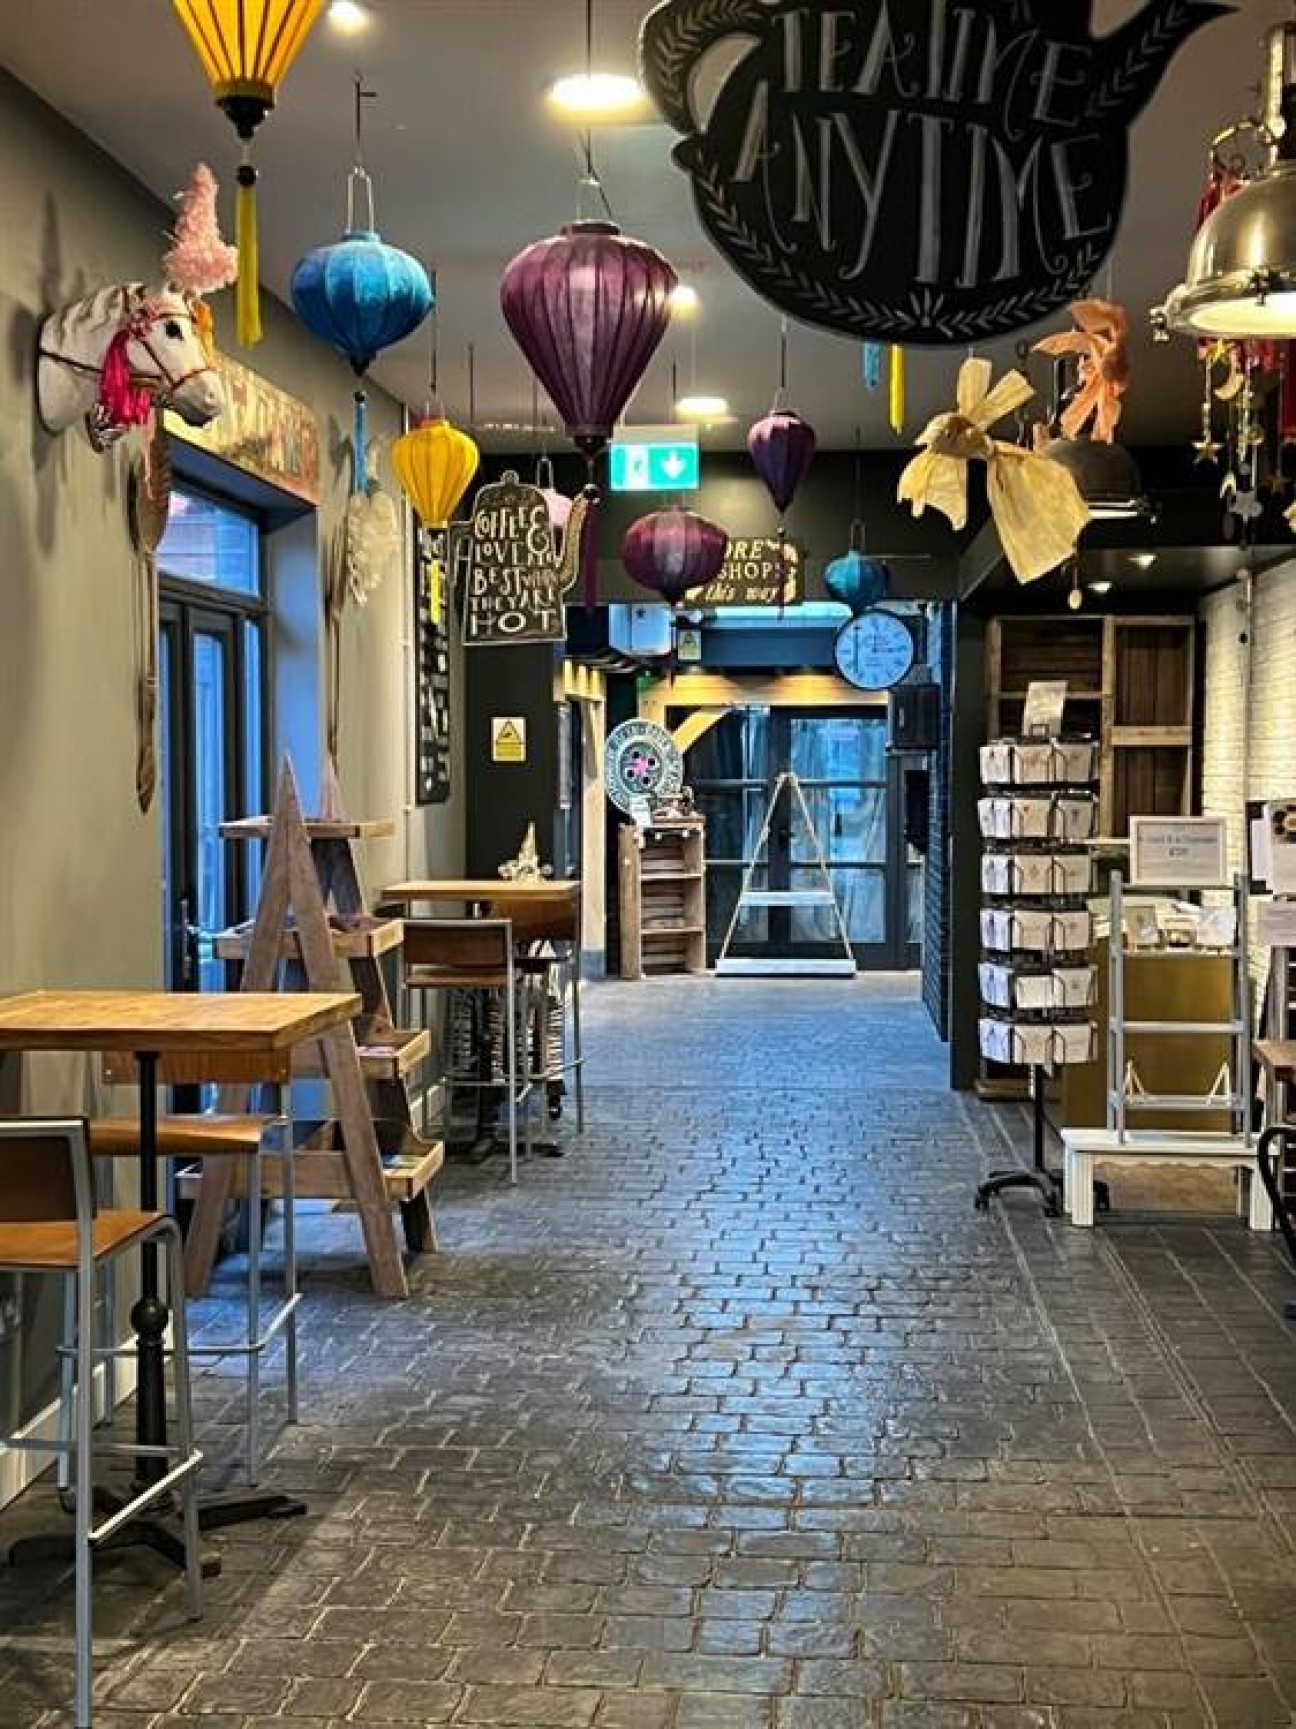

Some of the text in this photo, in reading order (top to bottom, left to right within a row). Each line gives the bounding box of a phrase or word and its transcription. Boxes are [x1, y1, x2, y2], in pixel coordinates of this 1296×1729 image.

[731, 79, 1114, 288] ANYTIME
[475, 541, 525, 565] LOVE
[474, 567, 527, 596] BEST
[470, 610, 557, 636] HOT
